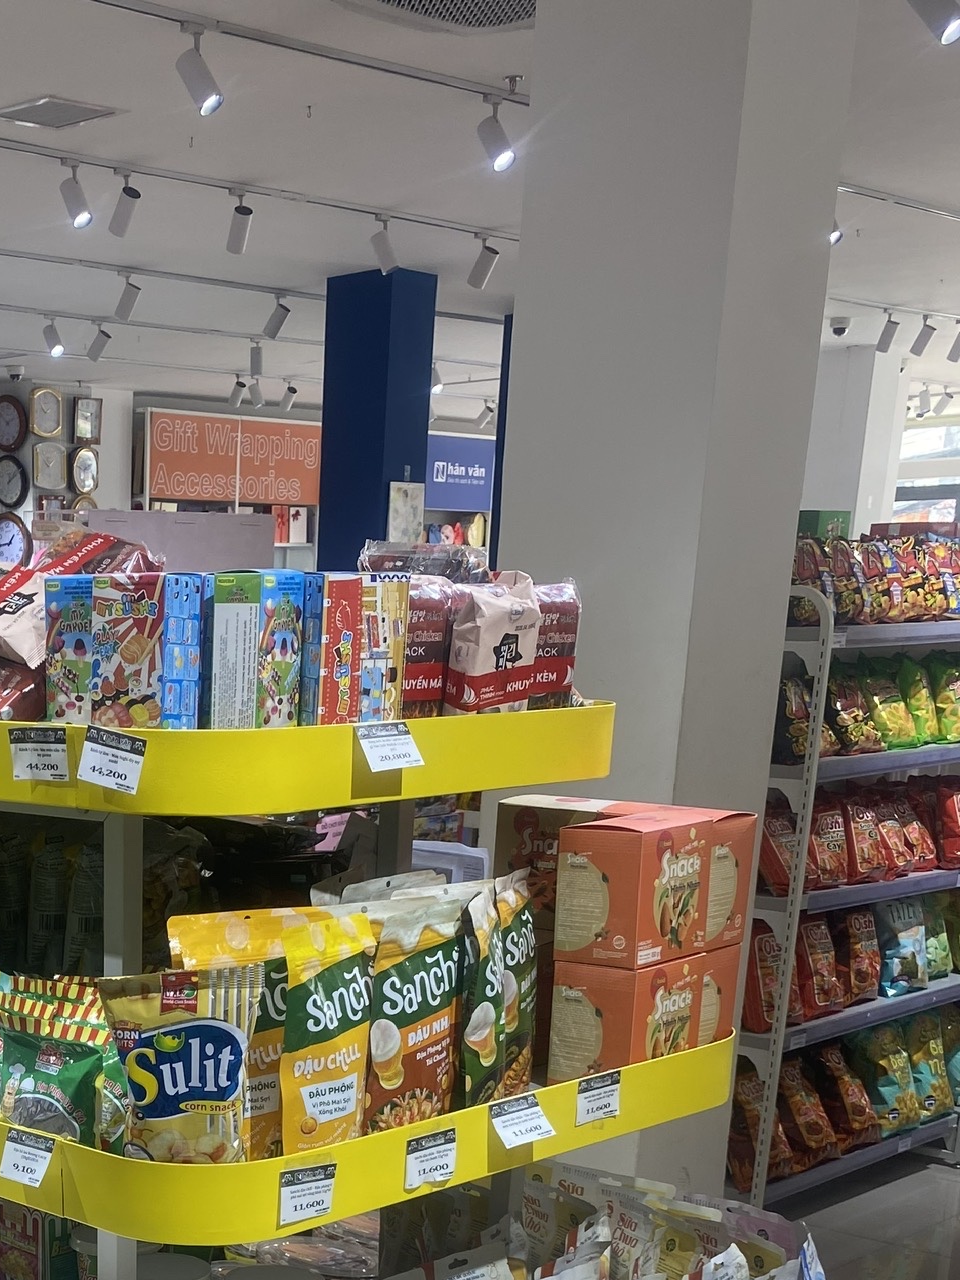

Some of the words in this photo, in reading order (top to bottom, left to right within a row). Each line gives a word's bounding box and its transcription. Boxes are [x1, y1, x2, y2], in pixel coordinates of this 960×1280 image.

[153, 419, 199, 453] Gift
[206, 422, 319, 469] Wrapping
[468, 464, 486, 477] văn
[152, 463, 301, 500] Accessories
[26, 763, 59, 772] 44,200
[90, 764, 128, 782] 44,200
[661, 849, 702, 885] Snack
[125, 1037, 235, 1107] Sulit
[184, 1102, 207, 1113] corn
[209, 1100, 238, 1113] snack
[292, 1198, 325, 1213] 11,600
